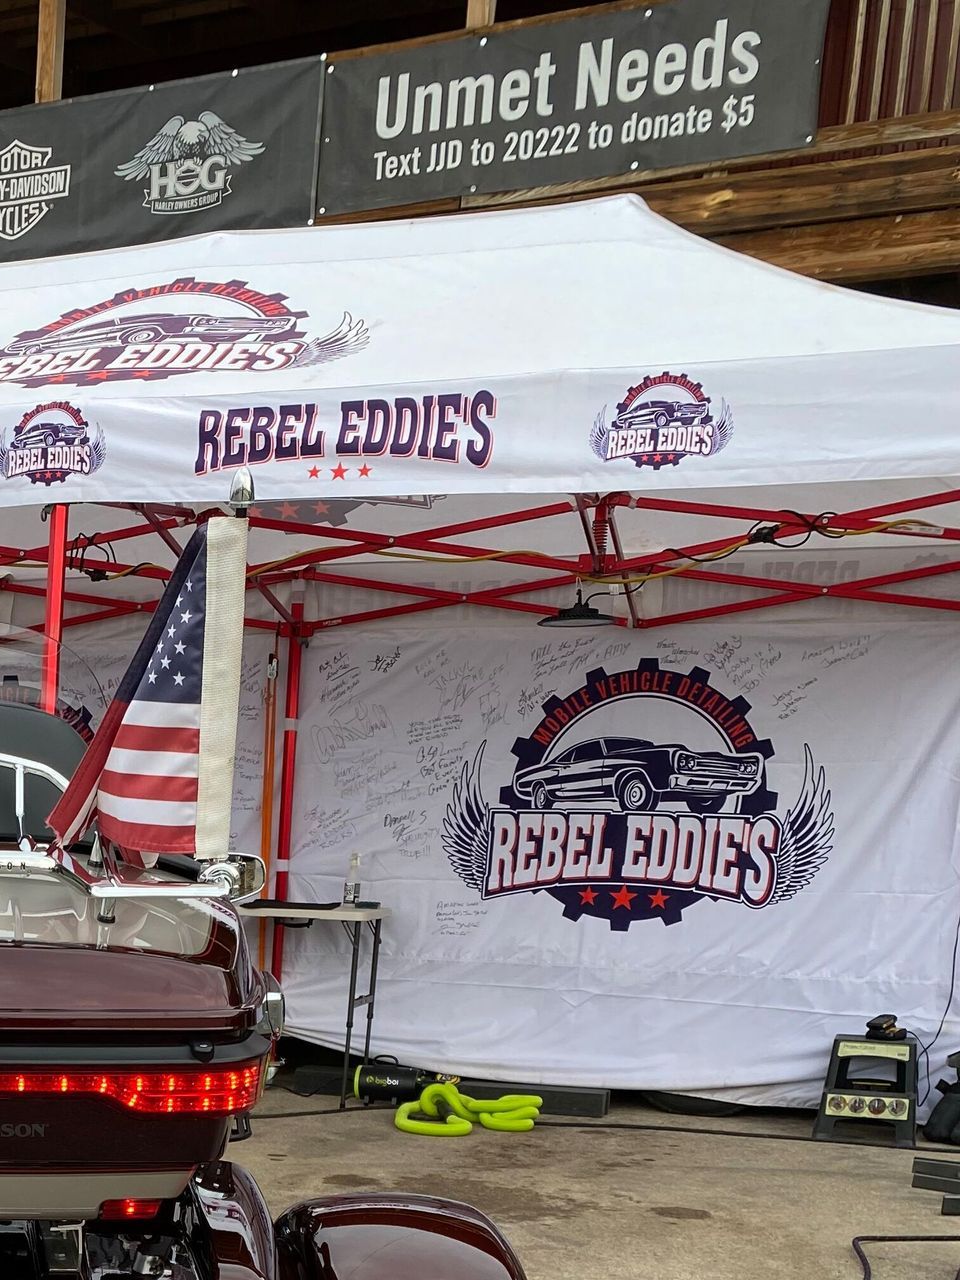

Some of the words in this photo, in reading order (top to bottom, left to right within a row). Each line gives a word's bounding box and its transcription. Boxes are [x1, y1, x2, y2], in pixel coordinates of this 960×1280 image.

[375, 52, 557, 139] Unmet
[574, 18, 762, 111] Needs
[374, 145, 422, 180] Text
[426, 139, 464, 173] JJD
[471, 136, 495, 166] to
[503, 122, 581, 163] 20222
[588, 120, 614, 150] to
[621, 103, 713, 145] donate
[720, 94, 756, 134] $5
[155, 200, 174, 210] HARLEY
[174, 197, 198, 210] OWNERS
[198, 192, 219, 208] GROUP
[44, 300, 114, 332] MOBILE
[123, 281, 208, 302] VEHICLE
[210, 283, 287, 316] DETAILING
[114, 341, 302, 373] EDDIE'S
[7, 448, 45, 478] REBEL
[194, 402, 327, 476] REBEL
[335, 389, 498, 470] EDDIE'S
[606, 428, 655, 460] REBEL
[656, 424, 714, 456] EDDIE'S
[533, 688, 593, 747] MOBILE
[595, 670, 673, 700] VEHICLE
[676, 676, 755, 749] DETAILING
[488, 813, 614, 891] REBEL
[621, 814, 780, 902] EDDIE'S
